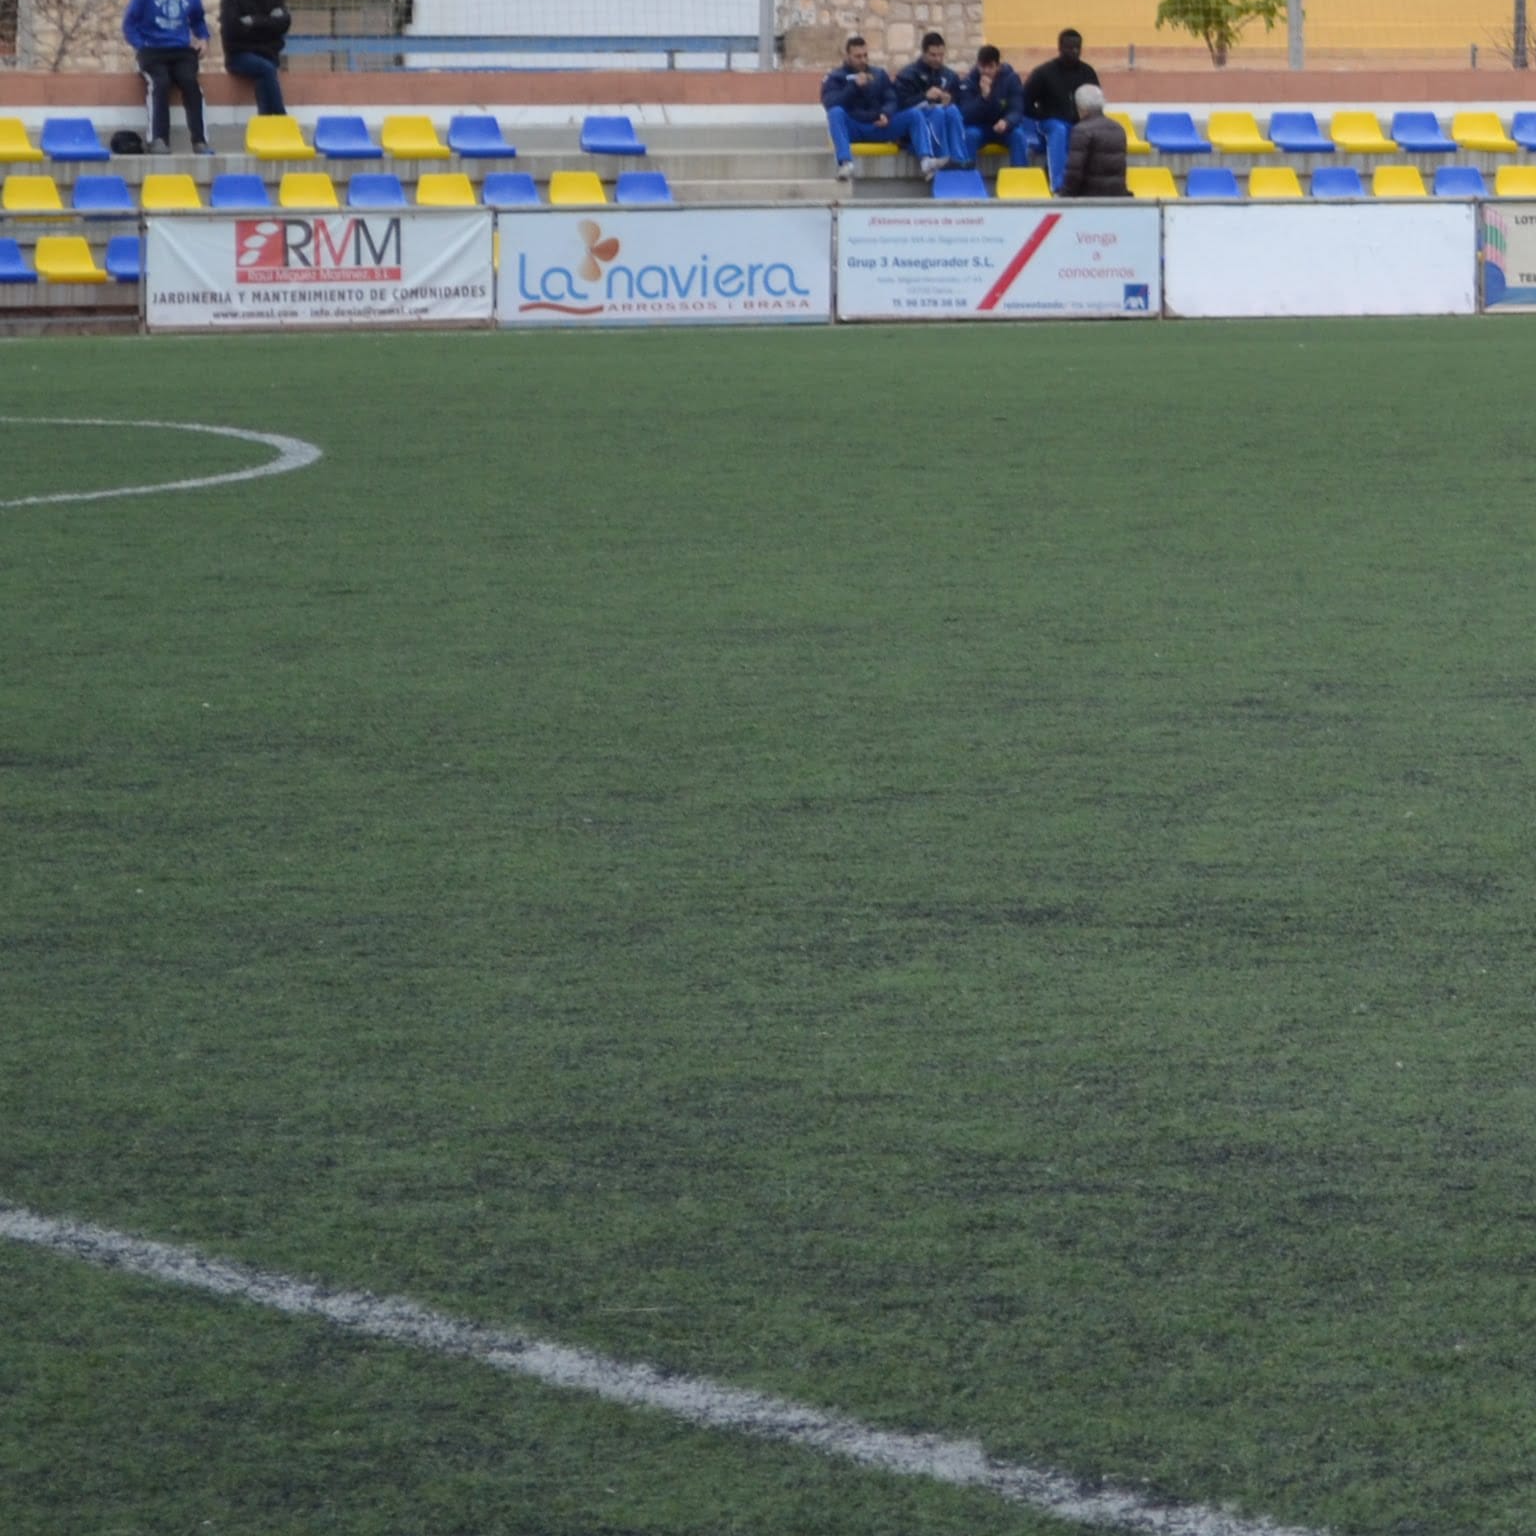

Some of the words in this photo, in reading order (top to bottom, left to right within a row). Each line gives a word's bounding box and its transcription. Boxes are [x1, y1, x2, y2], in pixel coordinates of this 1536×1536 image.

[283, 218, 402, 267] RMM
[1075, 232, 1118, 247] Venga
[847, 256, 877, 269] Grup
[880, 256, 888, 268] 3
[893, 256, 968, 270] Assegurador
[972, 256, 994, 268] S.L.
[1092, 251, 1102, 262] a
[606, 253, 810, 299] naviera
[152, 291, 232, 305] JARDINERIA
[238, 291, 246, 304] Y
[252, 288, 364, 304] MANTENIMIENTO
[370, 288, 386, 301] DE
[393, 285, 486, 301] COMUNIDADES
[607, 300, 718, 313] ARROSSOS
[743, 299, 810, 310] BRASA
